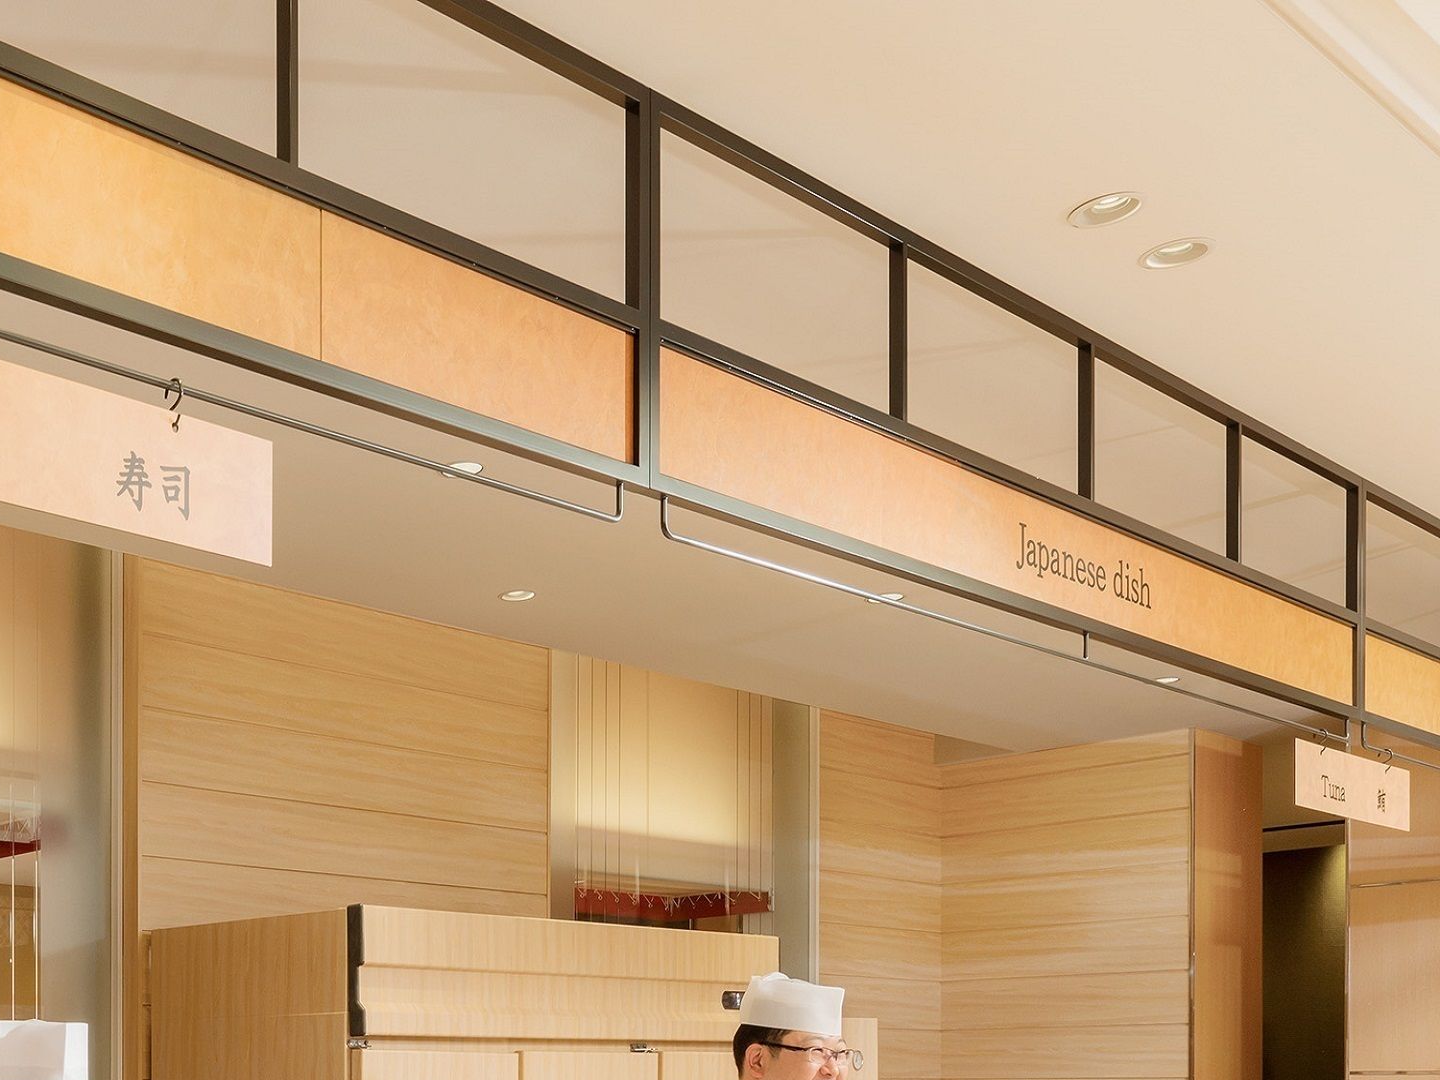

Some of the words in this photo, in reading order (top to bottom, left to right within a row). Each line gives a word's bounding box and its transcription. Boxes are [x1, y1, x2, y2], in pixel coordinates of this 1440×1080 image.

[116, 450, 191, 521] 寿司
[1016, 522, 1107, 592] Japanese
[1113, 560, 1152, 609] dish
[1321, 774, 1346, 803] Tuna
